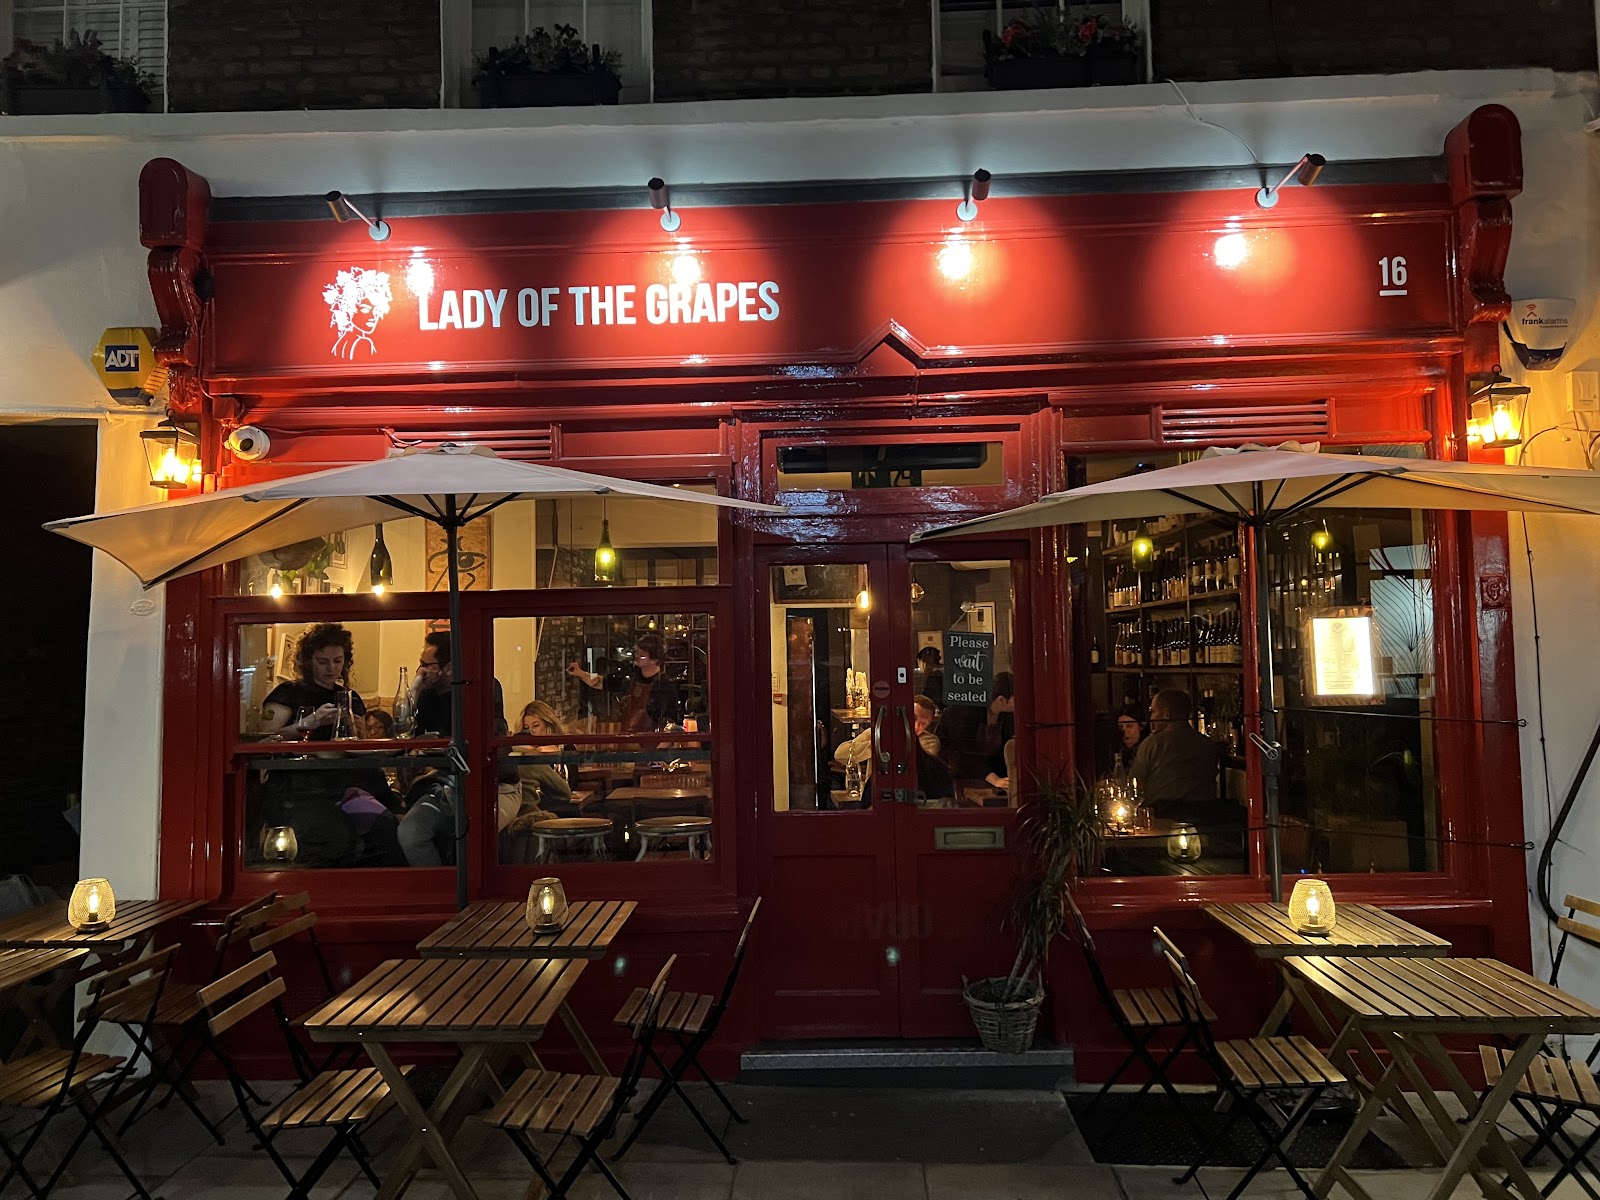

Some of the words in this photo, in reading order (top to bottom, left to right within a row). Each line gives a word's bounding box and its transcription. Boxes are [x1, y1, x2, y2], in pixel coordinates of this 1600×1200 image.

[1378, 256, 1407, 286] 16
[419, 288, 507, 330] LADY
[518, 287, 560, 327] OF
[568, 285, 636, 326] THE
[645, 281, 780, 325] GRAPES
[105, 350, 139, 368] ADT
[950, 635, 989, 649] Please
[954, 651, 988, 672] wait
[953, 673, 965, 685] to
[968, 673, 983, 685] be
[947, 691, 987, 702] seated
